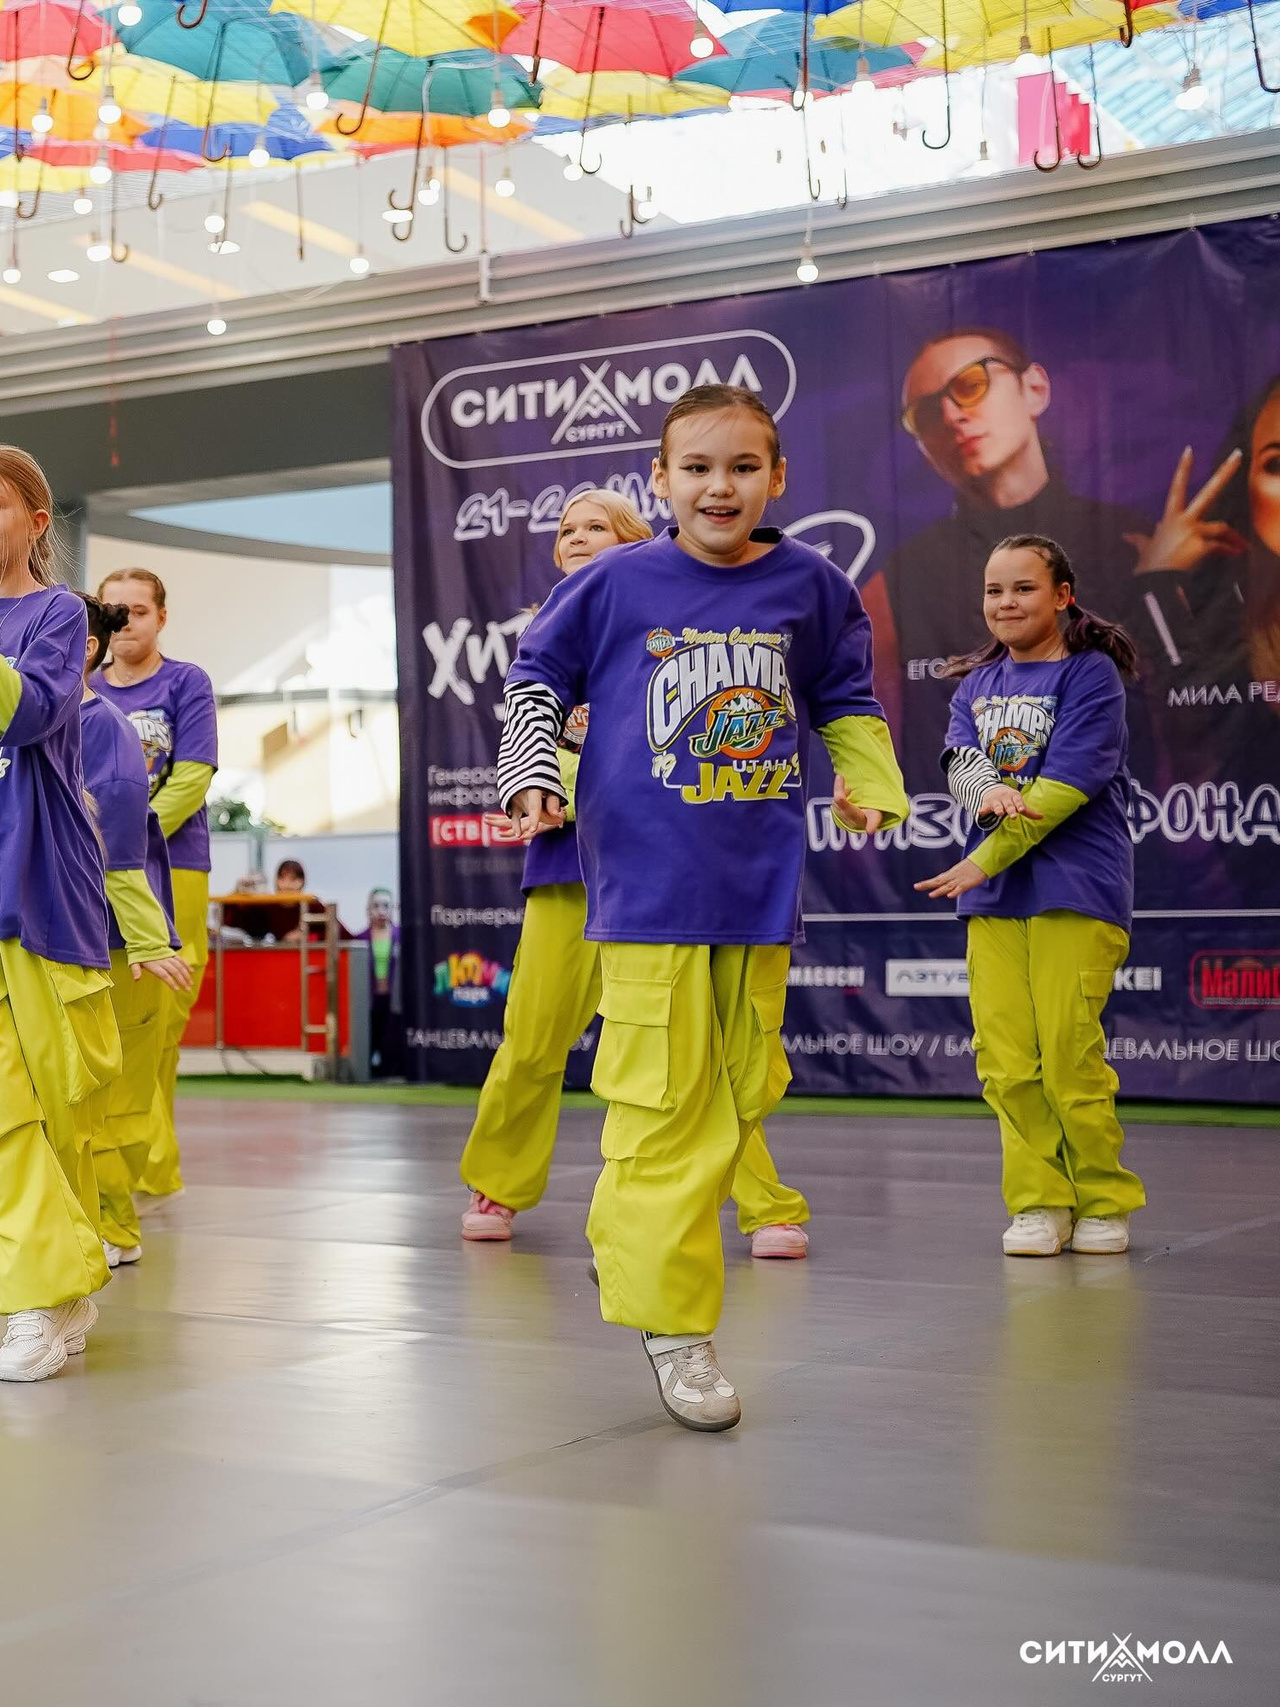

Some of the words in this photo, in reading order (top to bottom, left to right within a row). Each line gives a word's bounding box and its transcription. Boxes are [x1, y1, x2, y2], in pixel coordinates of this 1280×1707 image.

[451, 375, 578, 428] СИТИ
[565, 421, 627, 443] СУРГУТ
[453, 480, 596, 541] 21-2
[1168, 684, 1242, 707] МИЛА
[1248, 680, 1280, 703] РЕ
[732, 759, 787, 774] UTAH
[681, 762, 789, 805] JAZZ
[867, 1033, 925, 1057] ШОУ
